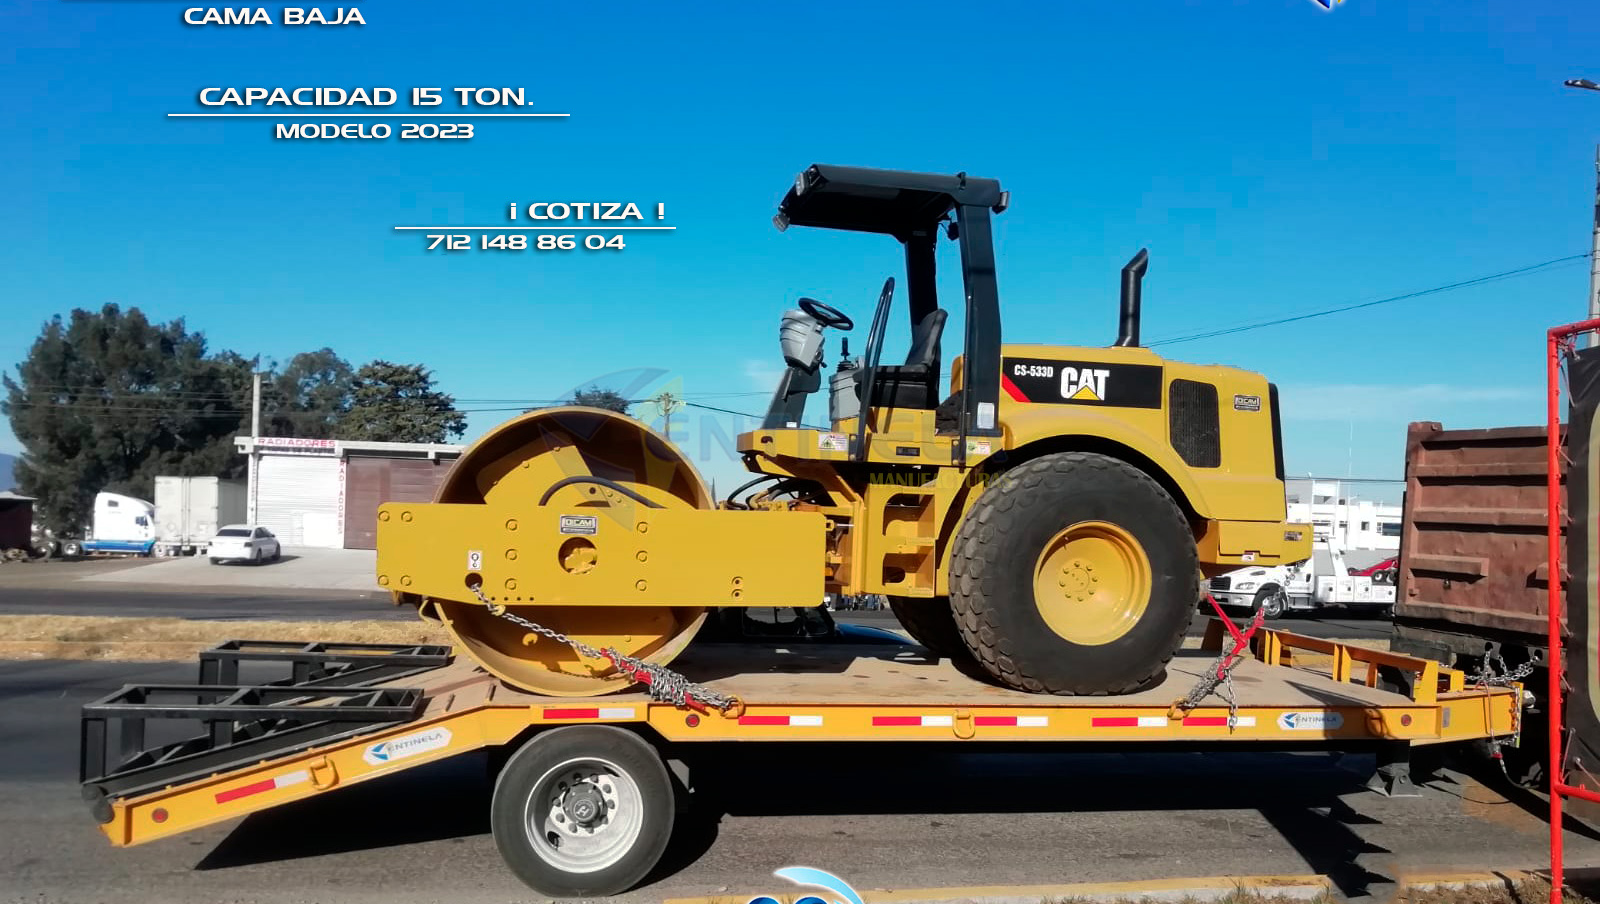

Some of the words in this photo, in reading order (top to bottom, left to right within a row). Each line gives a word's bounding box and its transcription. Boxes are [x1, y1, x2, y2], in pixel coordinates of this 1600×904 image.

[1014, 364, 1054, 378] CS-533D
[1060, 366, 1110, 401] CAT
[258, 438, 336, 447] RADIADORES
